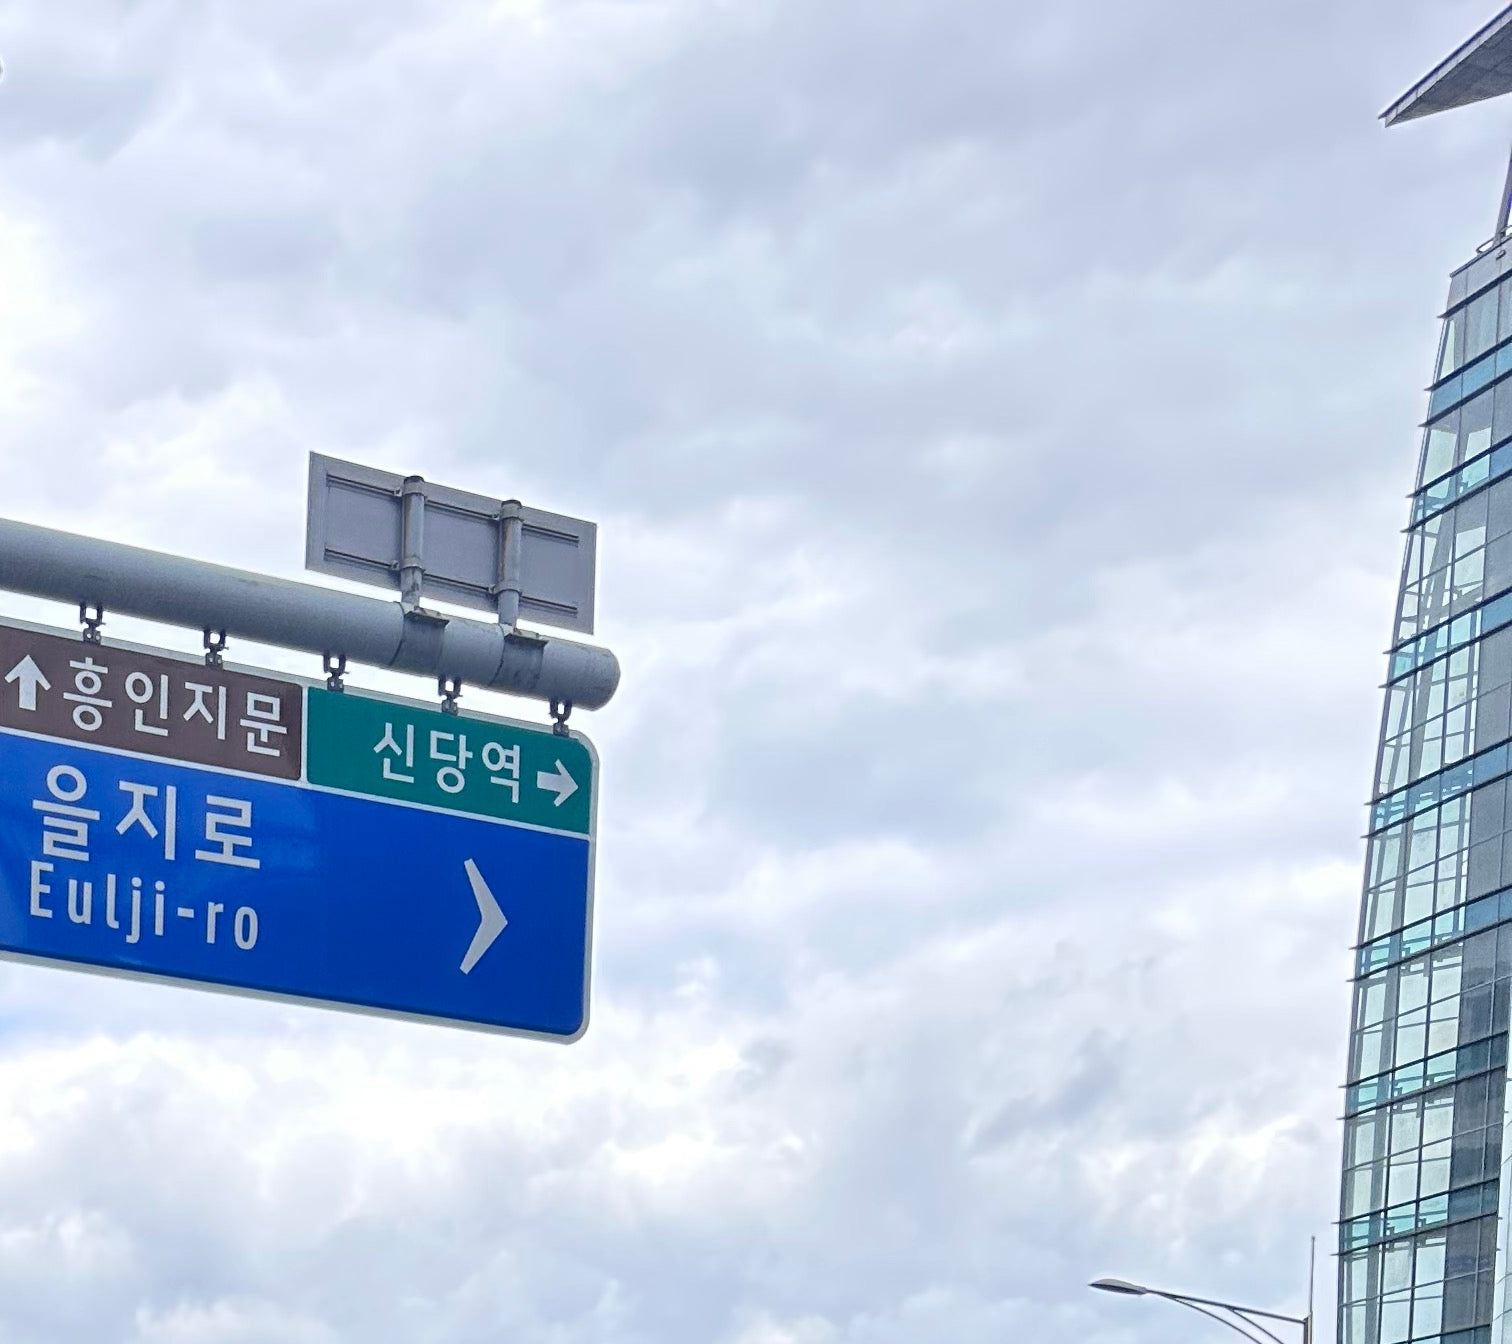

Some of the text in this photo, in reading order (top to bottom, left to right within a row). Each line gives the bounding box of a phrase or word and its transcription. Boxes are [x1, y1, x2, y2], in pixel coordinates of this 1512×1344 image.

[63, 656, 288, 758] 흥인지문
[373, 722, 523, 804] 신당역
[31, 764, 262, 871] 을지로
[29, 860, 260, 951] Eulji-ro
